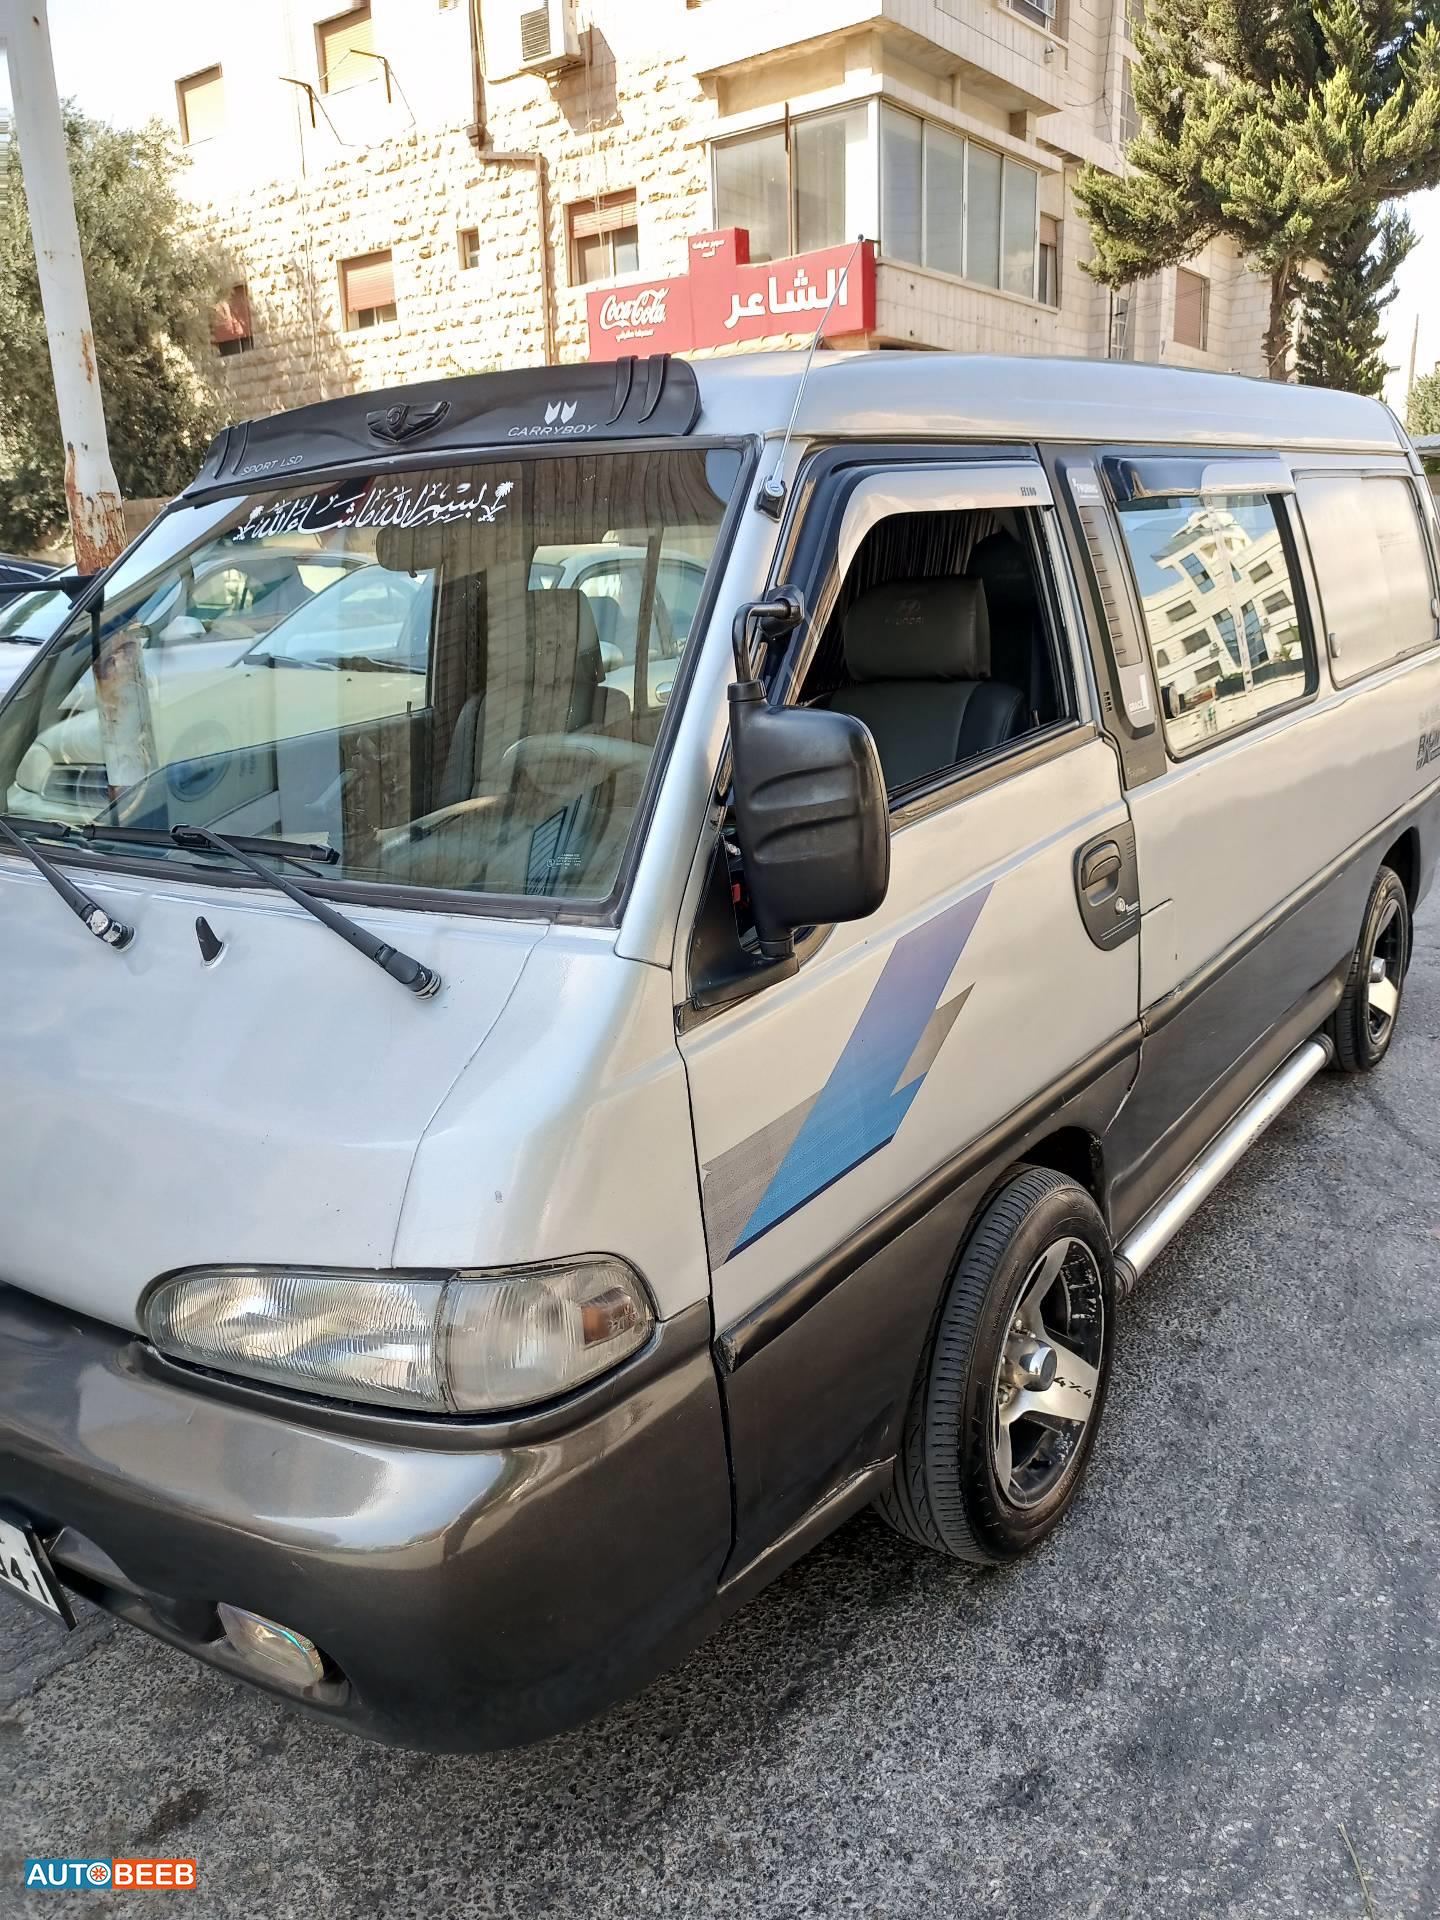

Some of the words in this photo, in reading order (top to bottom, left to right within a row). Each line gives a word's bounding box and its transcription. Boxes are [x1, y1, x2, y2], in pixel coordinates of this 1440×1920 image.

[599, 287, 670, 331] Coca-Cola
[723, 268, 848, 329] الشاعر
[507, 423, 598, 437] CARRYBOY
[240, 459, 279, 476] SPORT
[280, 454, 303, 467] LSD
